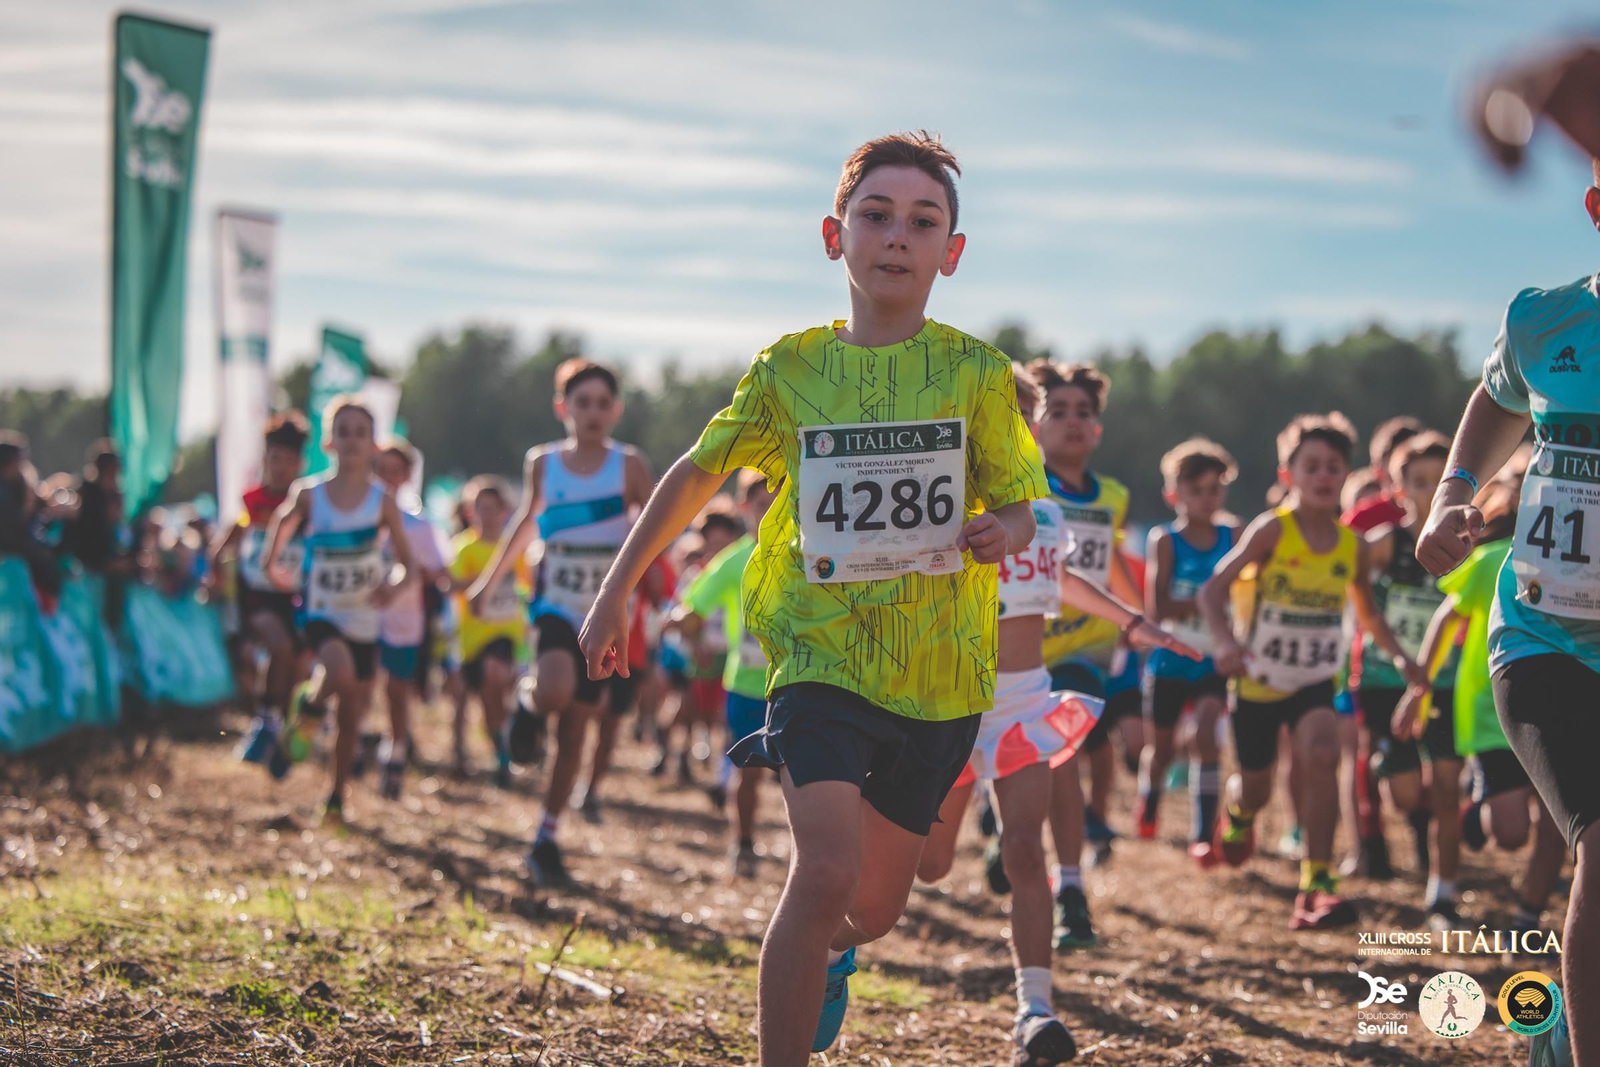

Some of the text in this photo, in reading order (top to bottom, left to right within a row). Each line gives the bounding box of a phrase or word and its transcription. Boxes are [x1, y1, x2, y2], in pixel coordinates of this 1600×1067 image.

[845, 430, 924, 451] ITÁLICA
[836, 458, 935, 469] VÍCTOR GONZÁLEZ MORENO
[857, 467, 915, 476] INDEPENDIENTE
[1556, 486, 1584, 496] HÉCTOR
[816, 475, 954, 532] 4286
[1263, 637, 1338, 668] 4134
